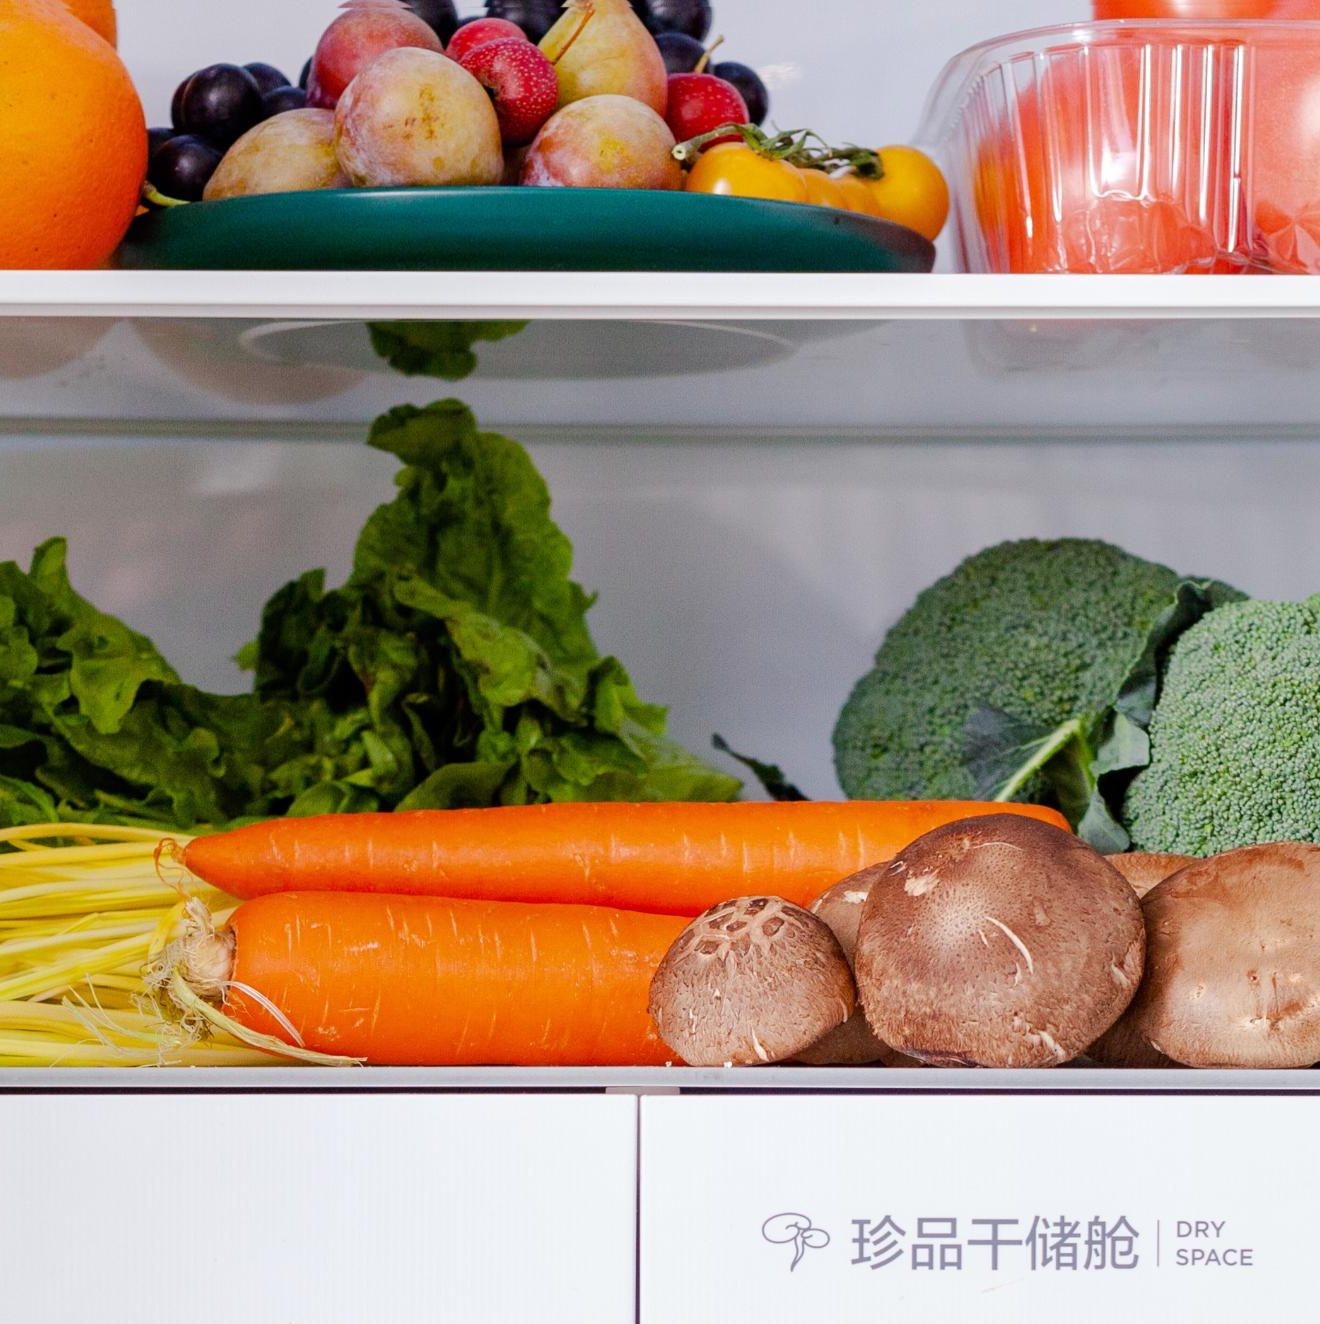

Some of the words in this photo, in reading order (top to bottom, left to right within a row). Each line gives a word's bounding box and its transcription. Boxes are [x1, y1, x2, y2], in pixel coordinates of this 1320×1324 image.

[1176, 1220, 1227, 1238] DRY
[850, 1214, 1140, 1271] 珍品干储舱
[1175, 1248, 1254, 1267] SPACE
